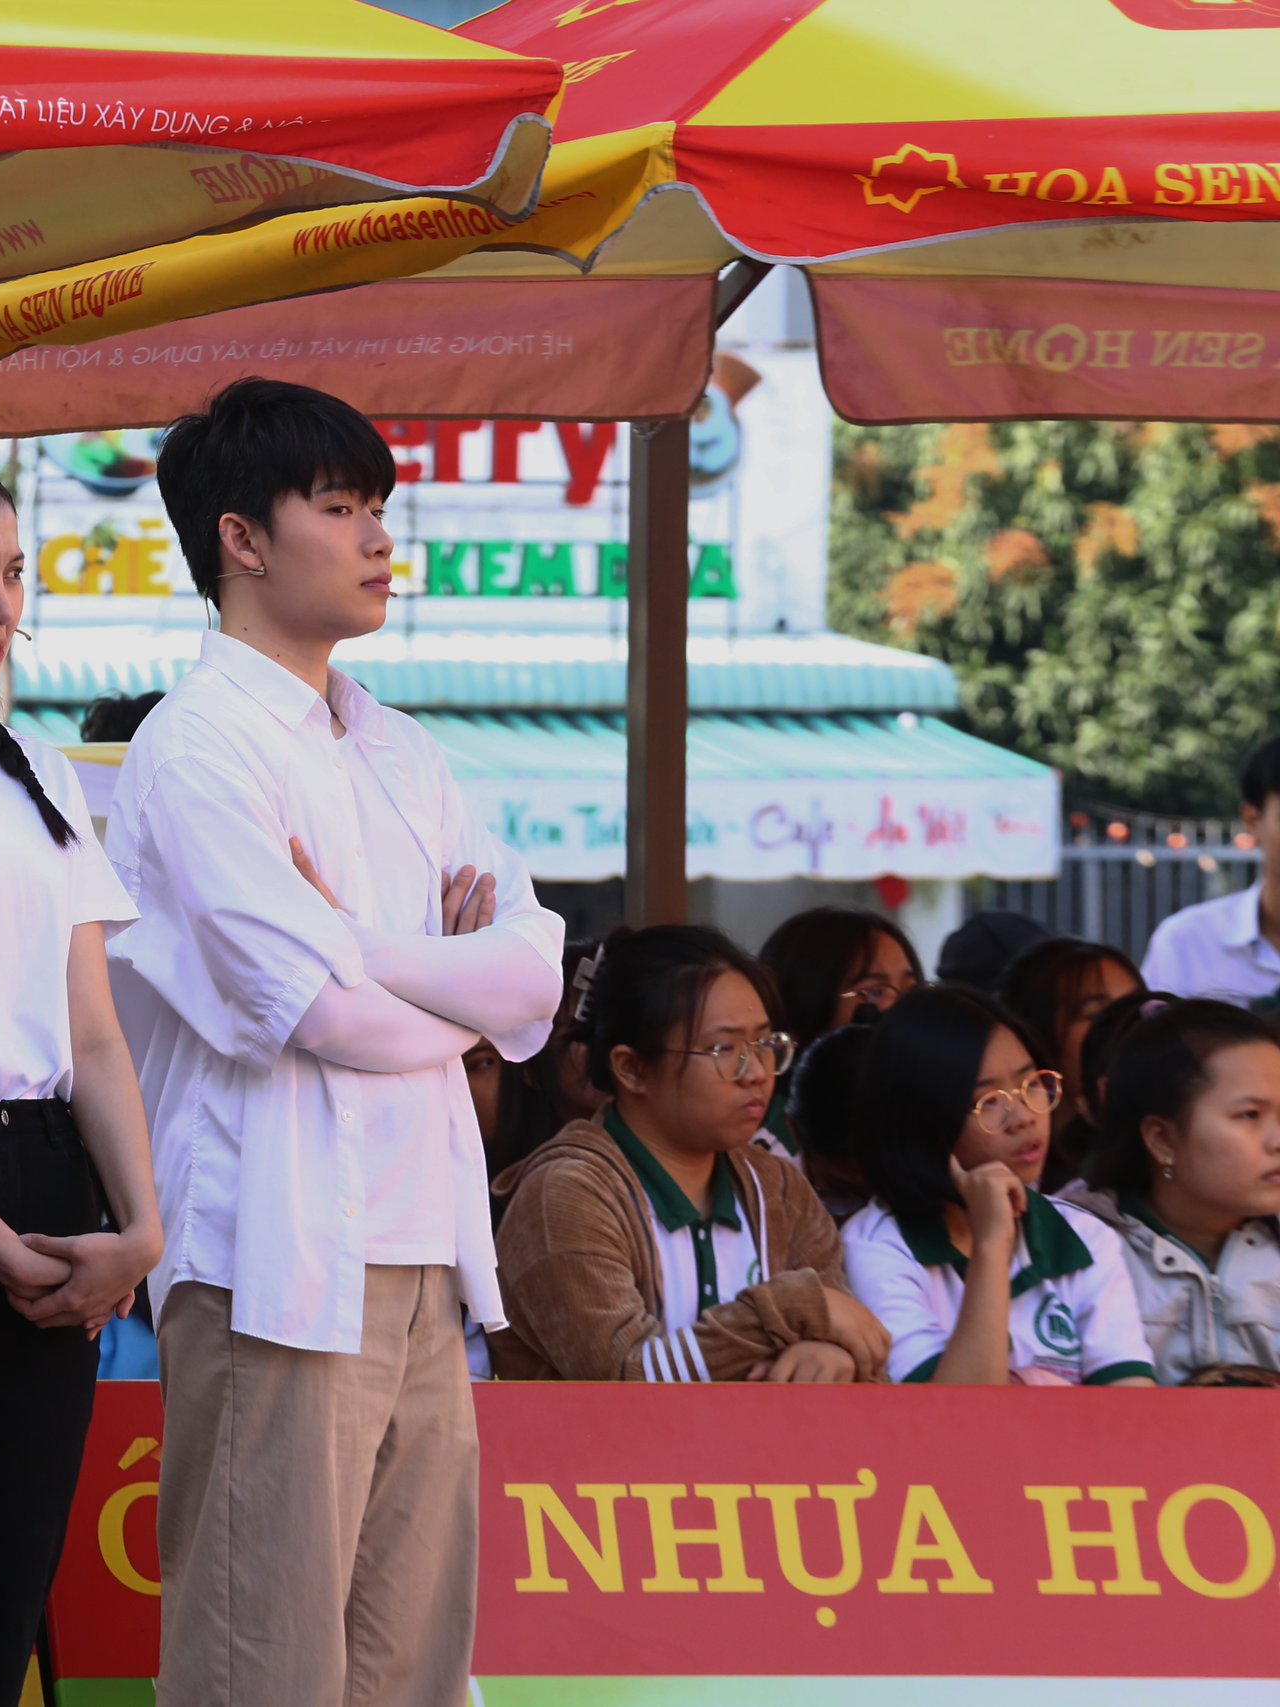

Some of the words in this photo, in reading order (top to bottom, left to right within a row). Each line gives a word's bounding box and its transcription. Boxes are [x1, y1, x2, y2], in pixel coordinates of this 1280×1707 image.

[38, 97, 87, 129] LIỆU
[93, 100, 146, 130] XÂY
[150, 109, 230, 138] DỰNG
[983, 167, 1133, 205] HOA
[1153, 162, 1280, 205] SEN
[293, 192, 596, 257] www.hoasenho
[19, 284, 68, 336] SEN
[71, 260, 158, 319] HOME
[372, 420, 617, 507] erry
[427, 540, 578, 598] KEM
[596, 532, 738, 599] DA
[503, 1467, 995, 1628] NHỰA
[1023, 1483, 1280, 1600] HO
